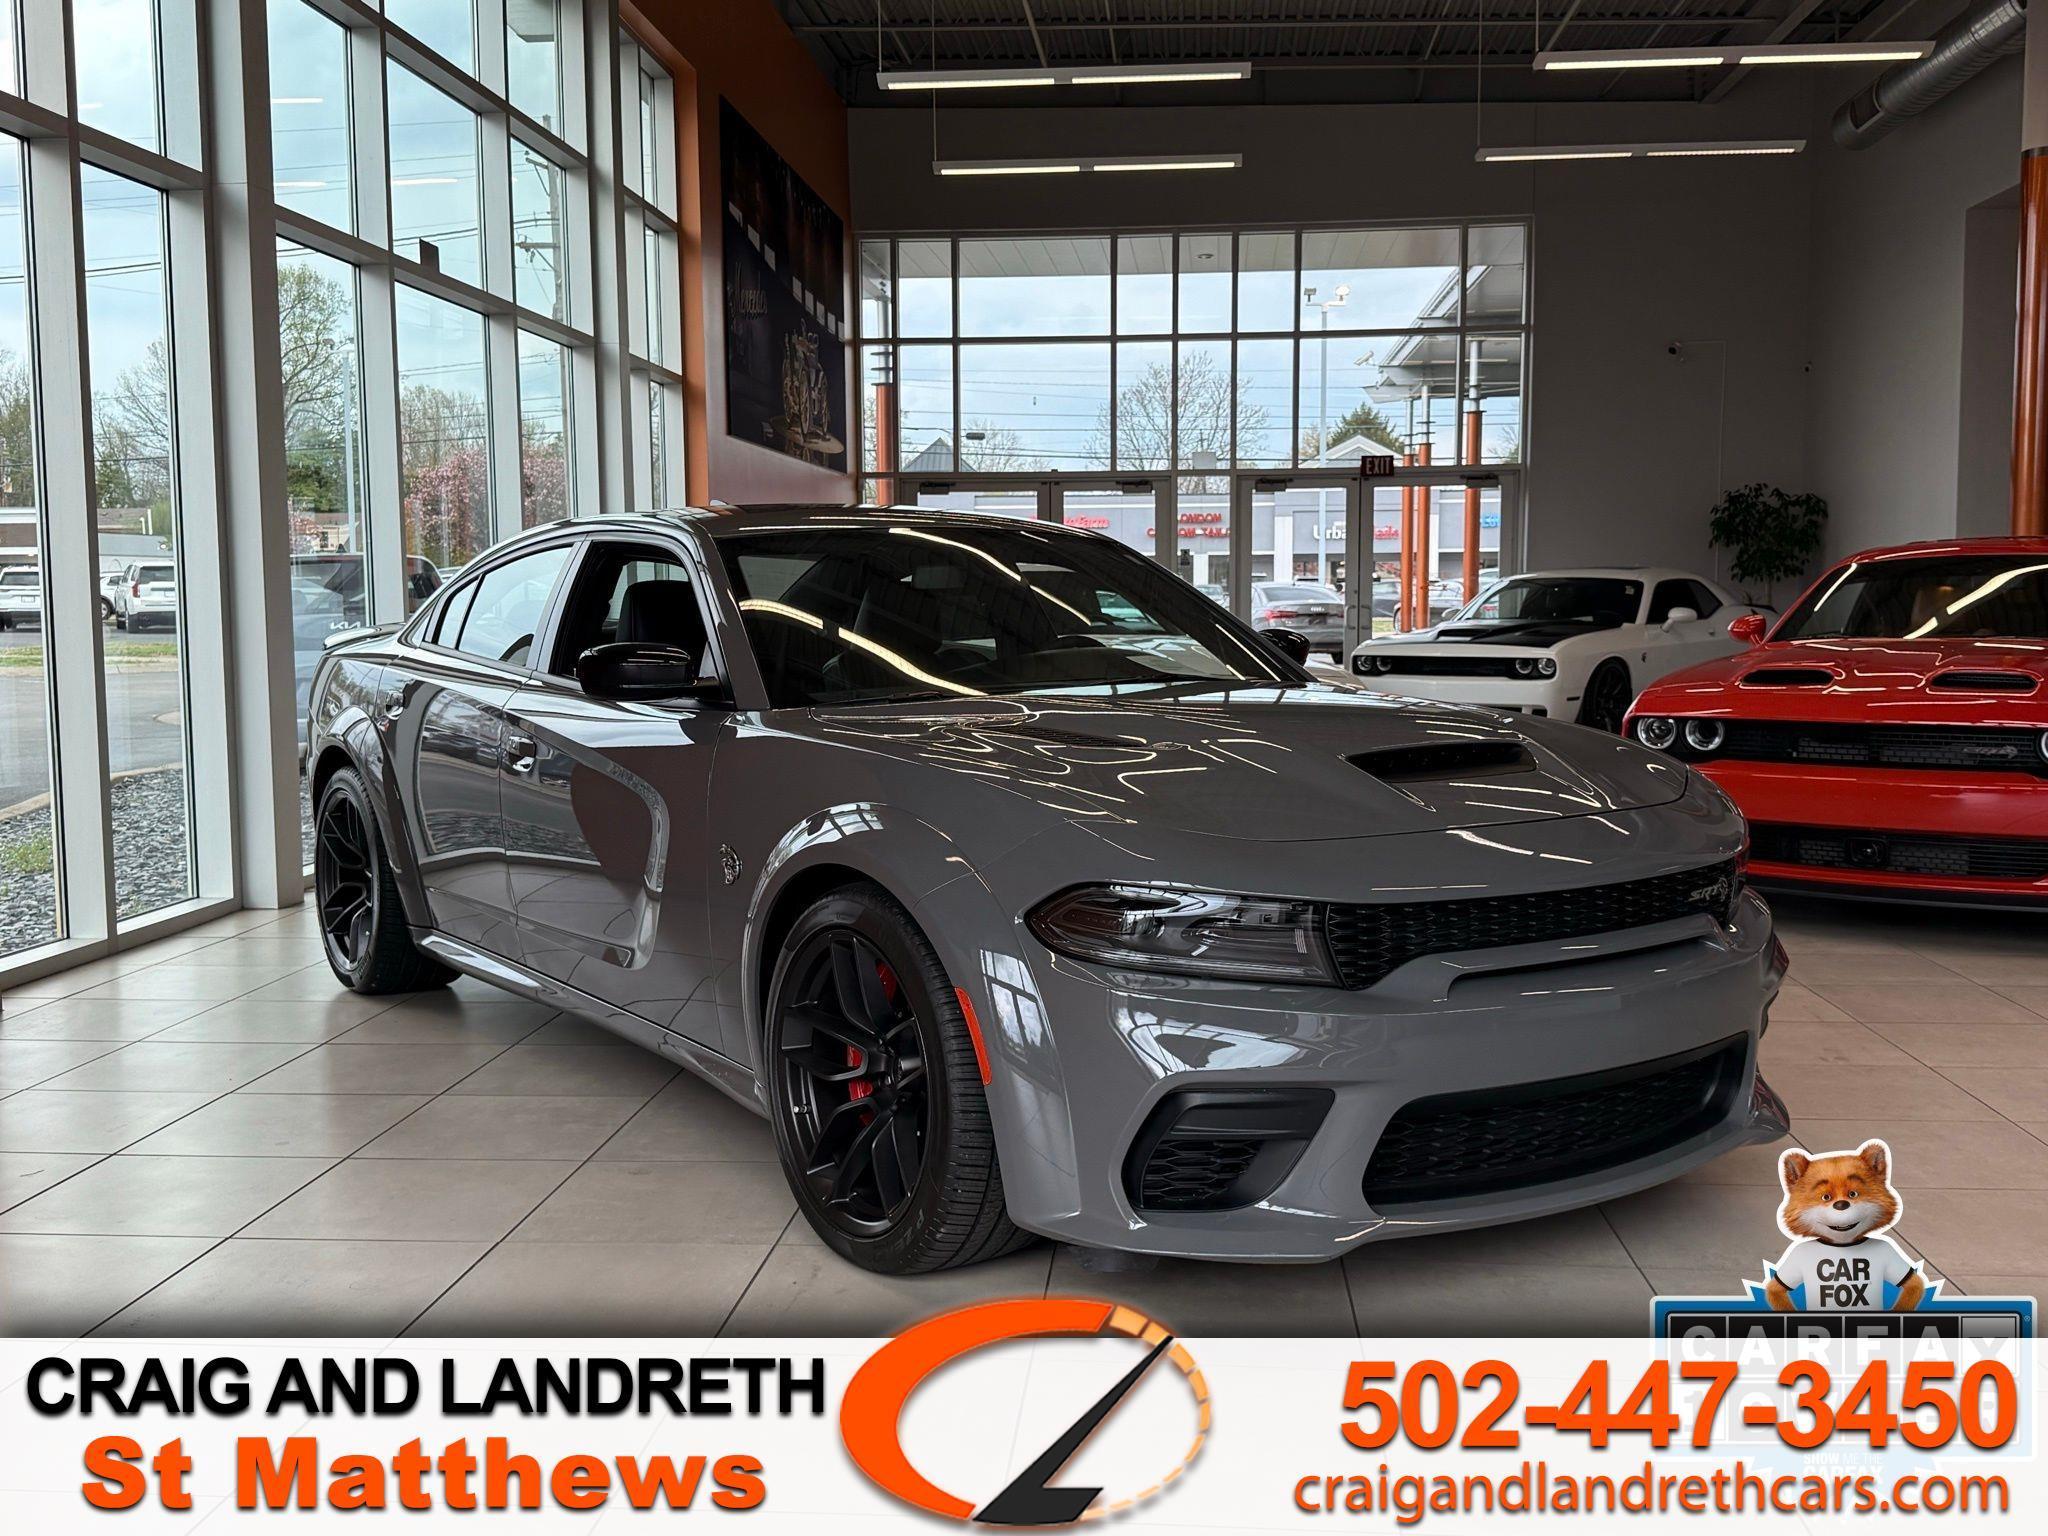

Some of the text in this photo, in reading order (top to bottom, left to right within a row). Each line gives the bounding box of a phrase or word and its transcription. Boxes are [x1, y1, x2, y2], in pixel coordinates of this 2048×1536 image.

[1365, 457, 1392, 475] EXIT
[1178, 513, 1222, 524] ONDON
[1374, 525, 1399, 539] ails
